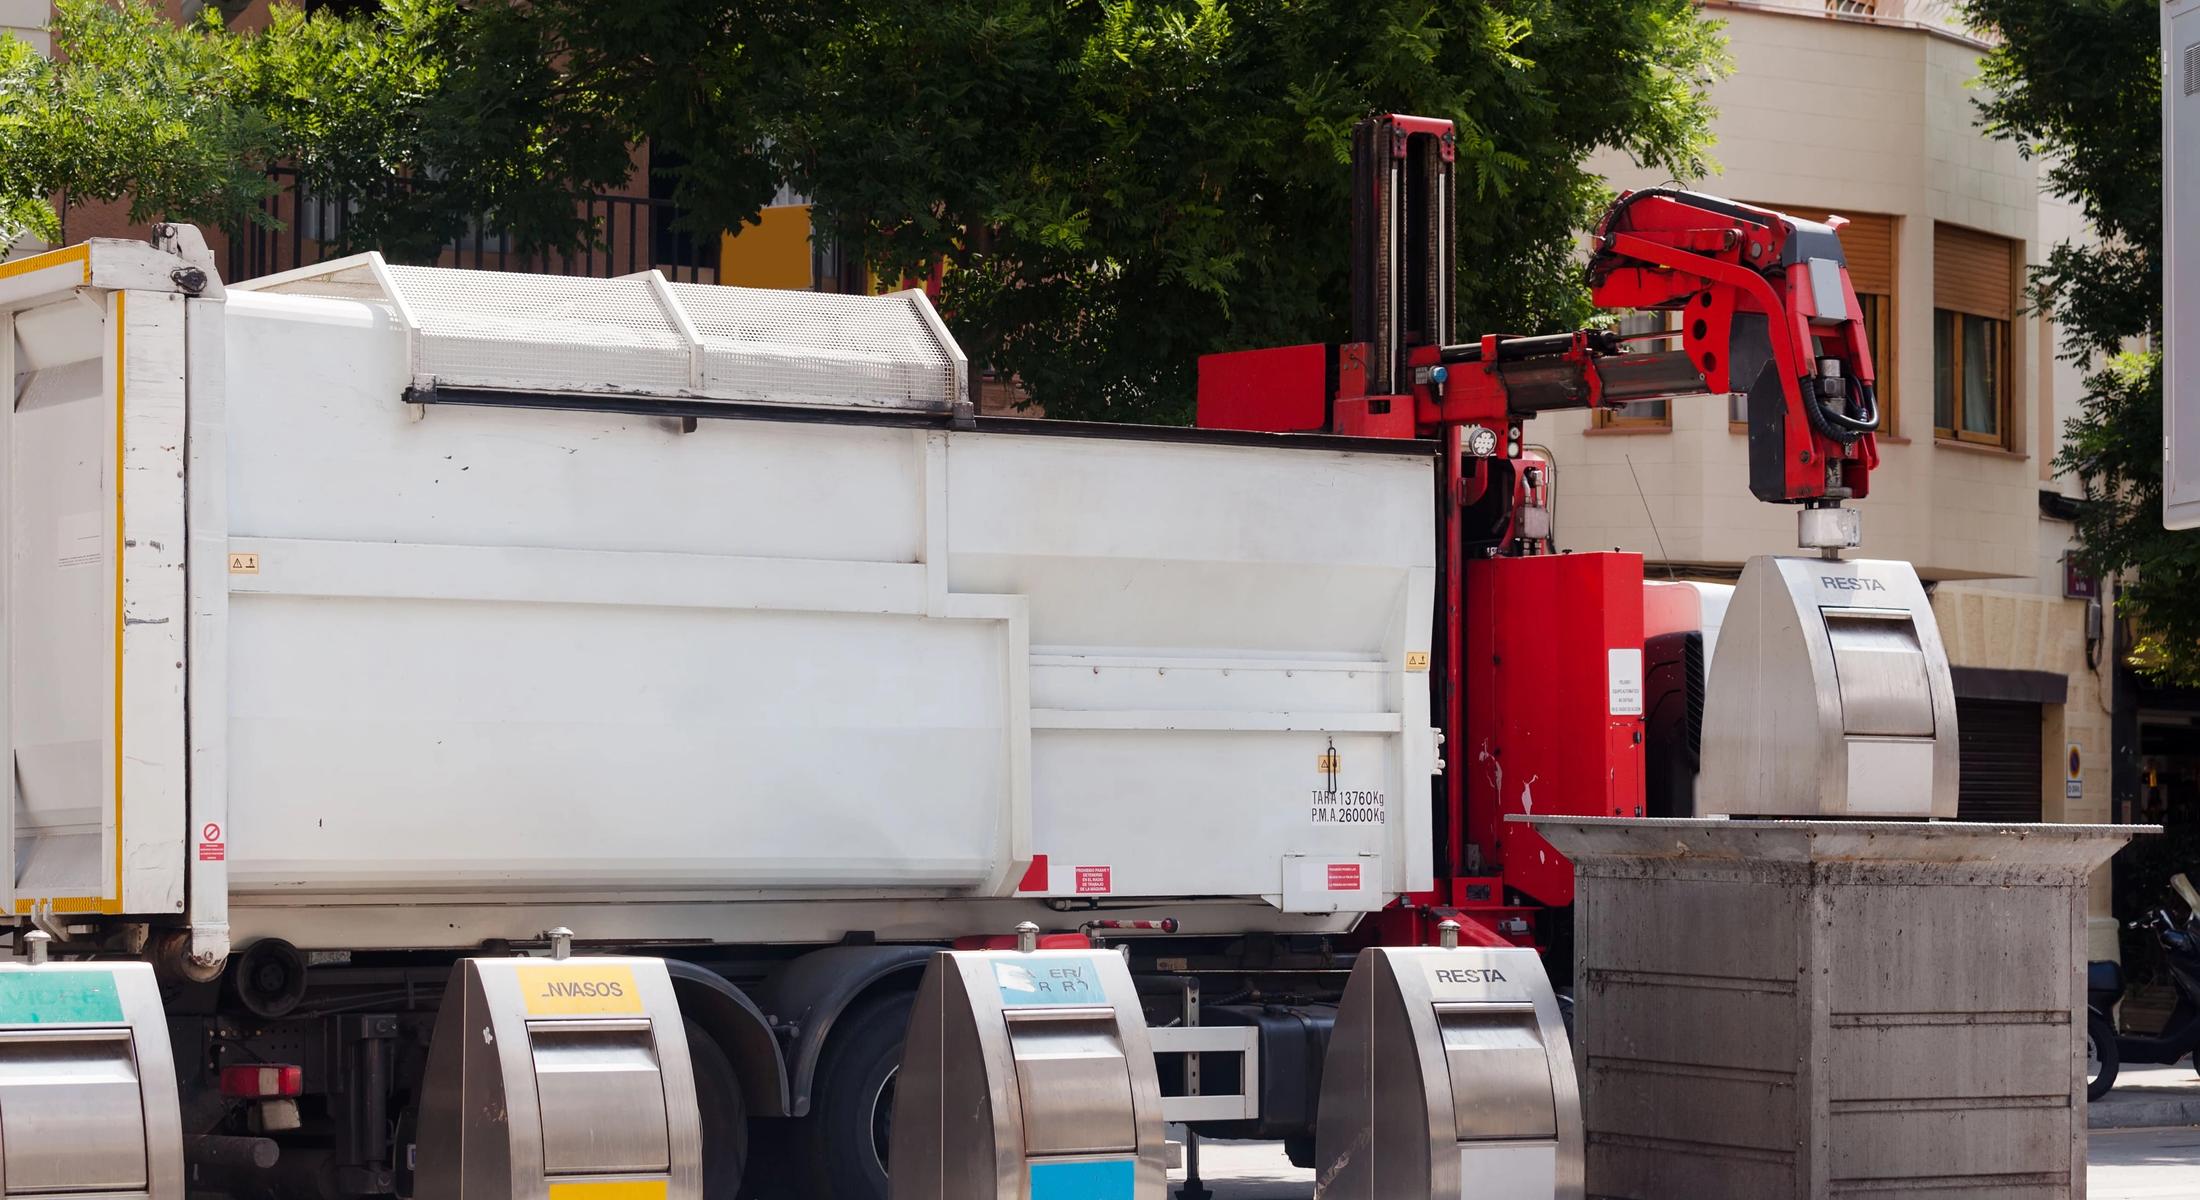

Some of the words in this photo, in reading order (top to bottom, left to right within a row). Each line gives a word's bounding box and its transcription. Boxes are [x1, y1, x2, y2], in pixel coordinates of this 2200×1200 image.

[1821, 576, 1886, 591] RESTA
[1312, 791, 1337, 805] TARA
[1435, 969, 1507, 982] RESTA
[541, 982, 623, 997] NVASOS
